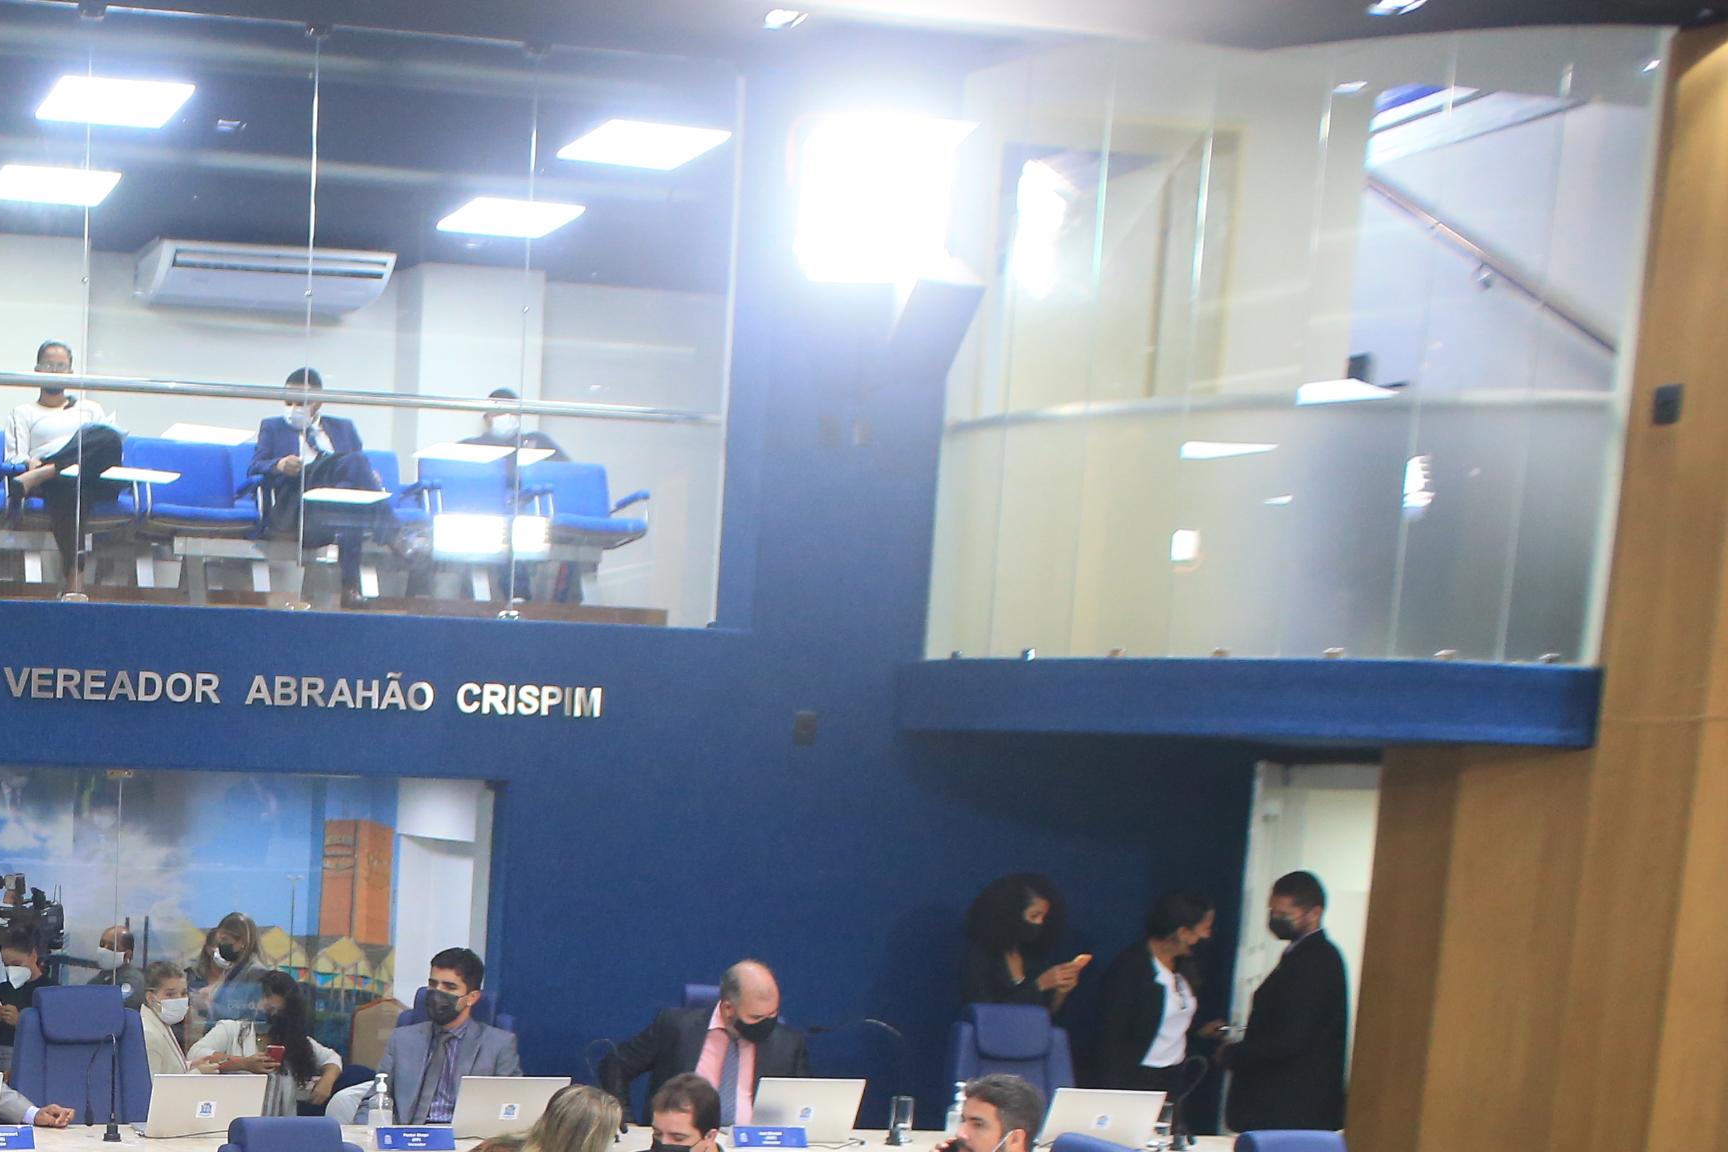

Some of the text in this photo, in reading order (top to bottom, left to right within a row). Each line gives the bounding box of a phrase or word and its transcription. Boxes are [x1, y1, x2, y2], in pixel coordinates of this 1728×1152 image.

[4, 667, 221, 704] VEREADOR
[244, 671, 435, 712] ABRAHÃO
[456, 681, 603, 718] CRISPIM
